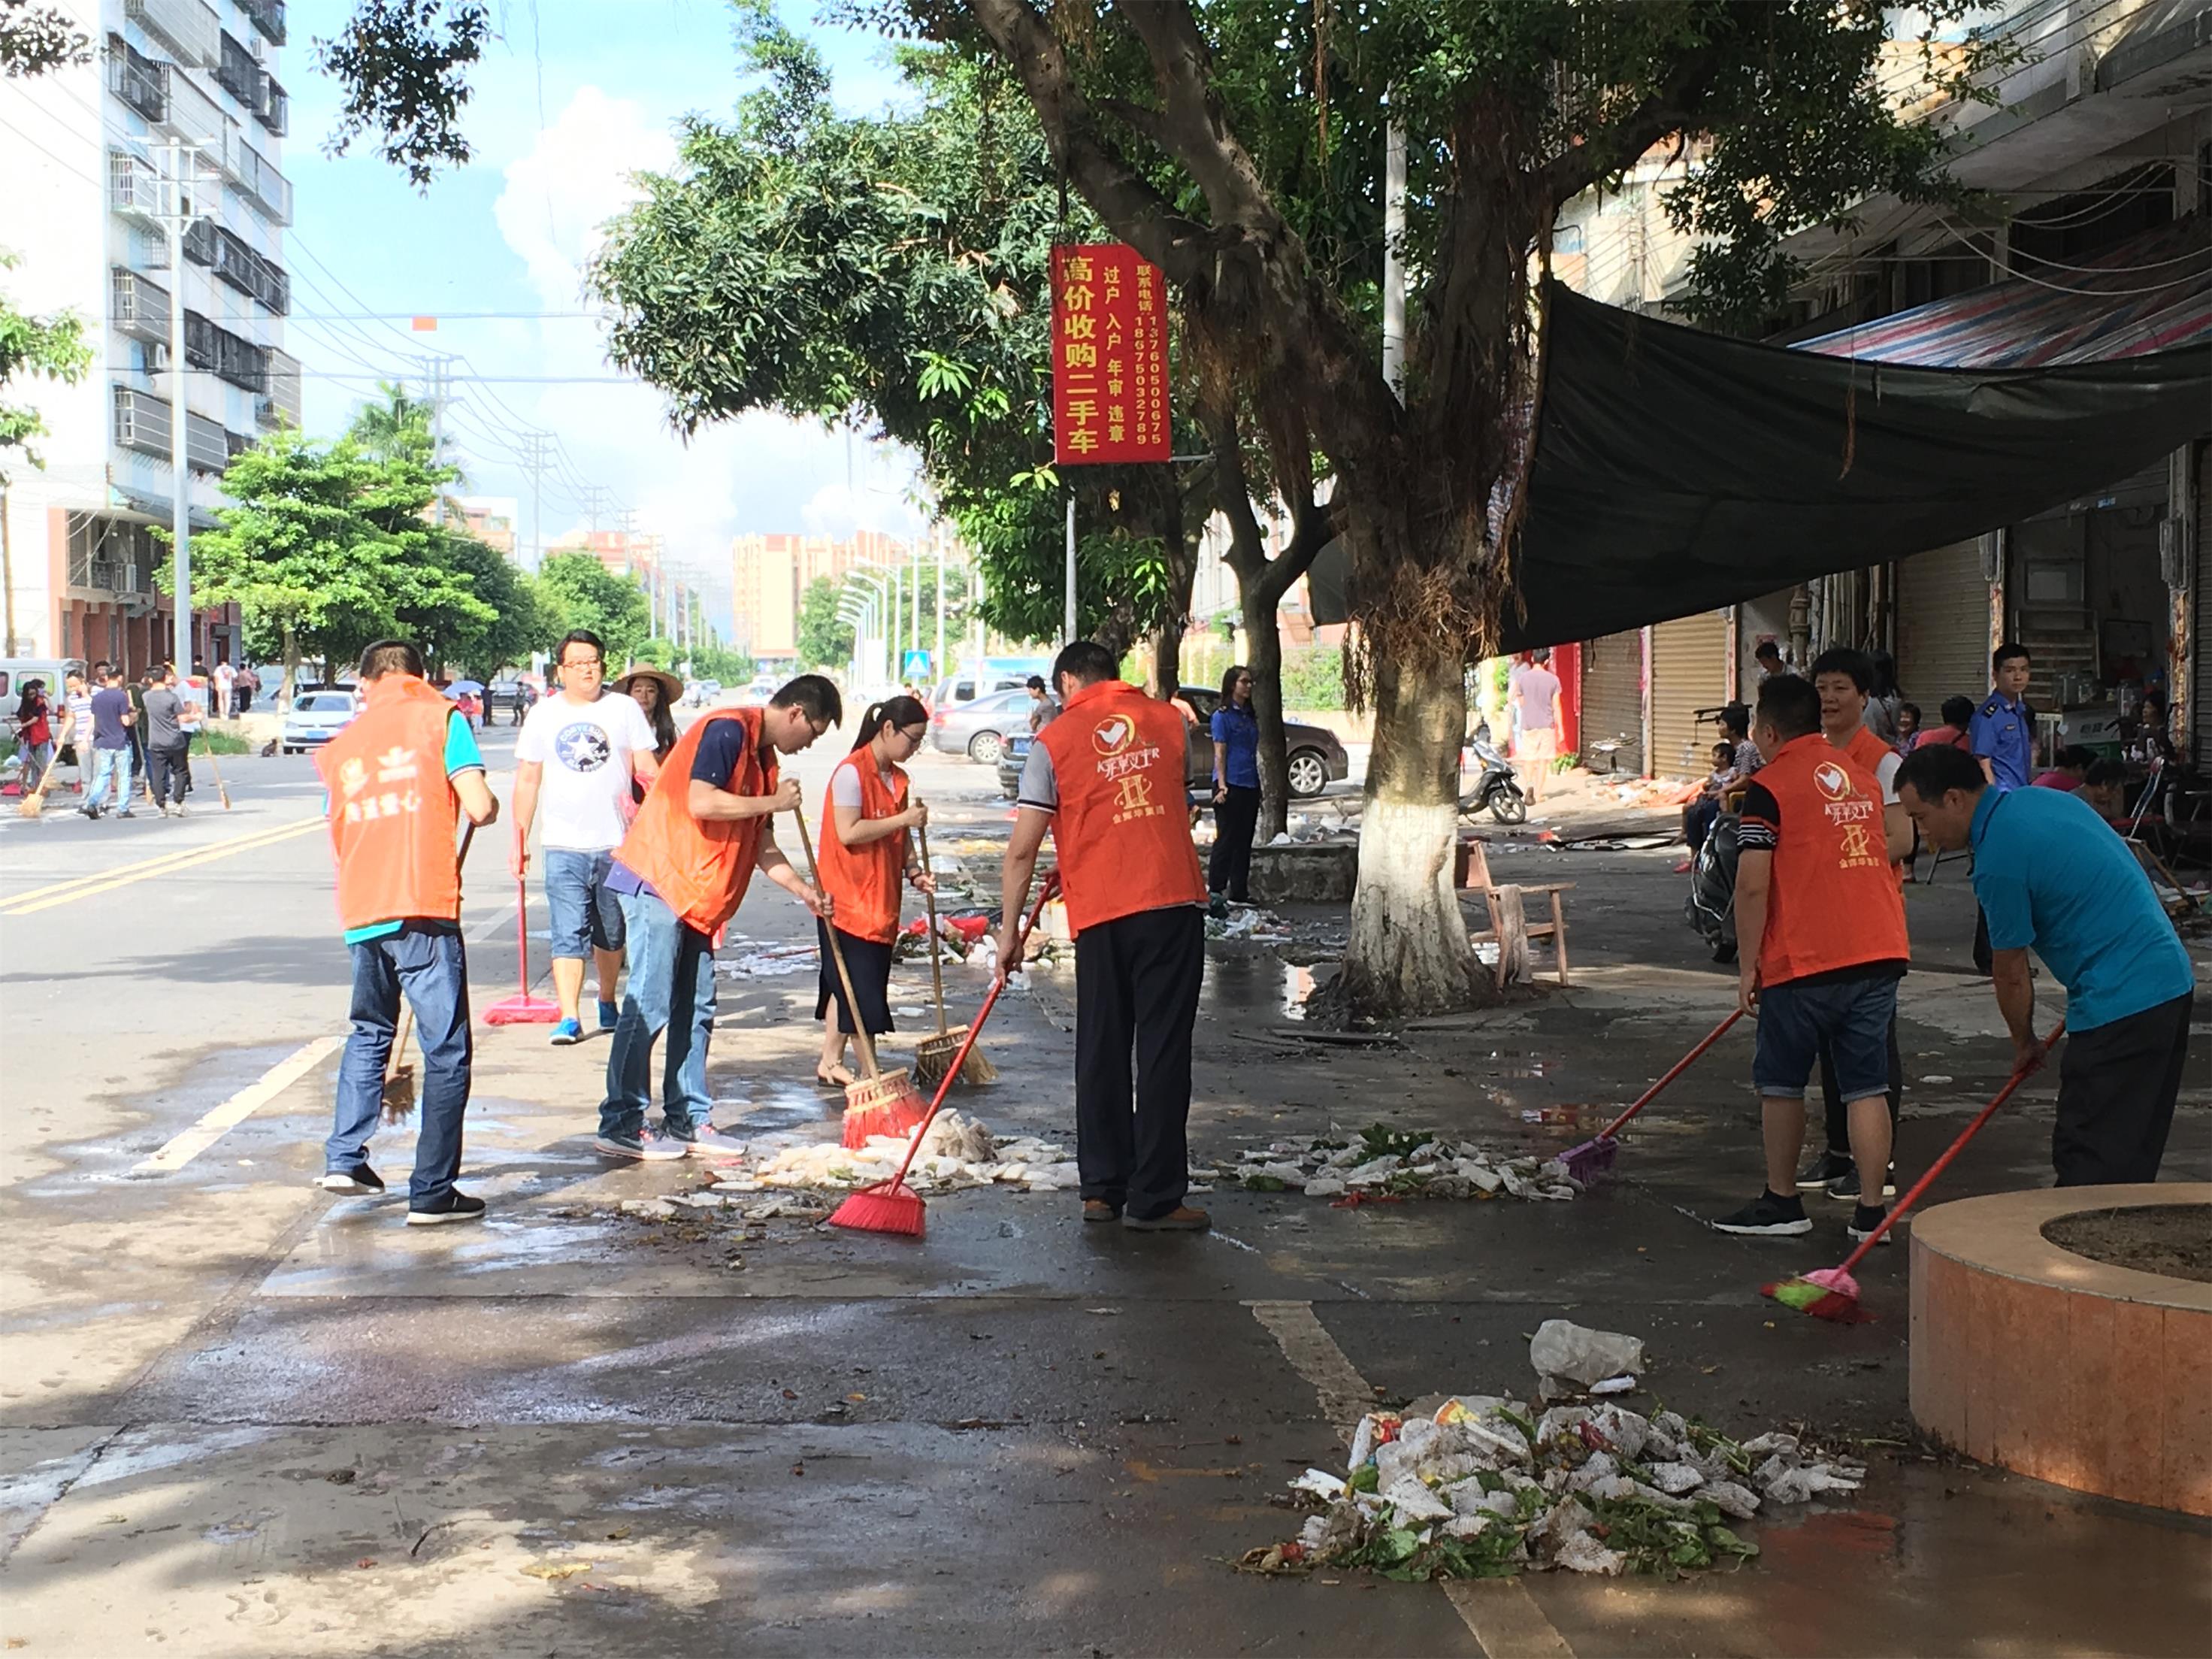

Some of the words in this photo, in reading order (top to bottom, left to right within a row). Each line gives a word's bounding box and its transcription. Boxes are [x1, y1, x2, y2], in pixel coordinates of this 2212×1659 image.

[1103, 265, 1121, 304] 过户
[1106, 313, 1122, 352] 入户
[1061, 256, 1100, 454] 高价收购二手车
[1107, 359, 1124, 397] 年审
[1134, 316, 1146, 446] 18675032789
[1149, 316, 1161, 445] 13760500675
[1108, 405, 1125, 444] 违章
